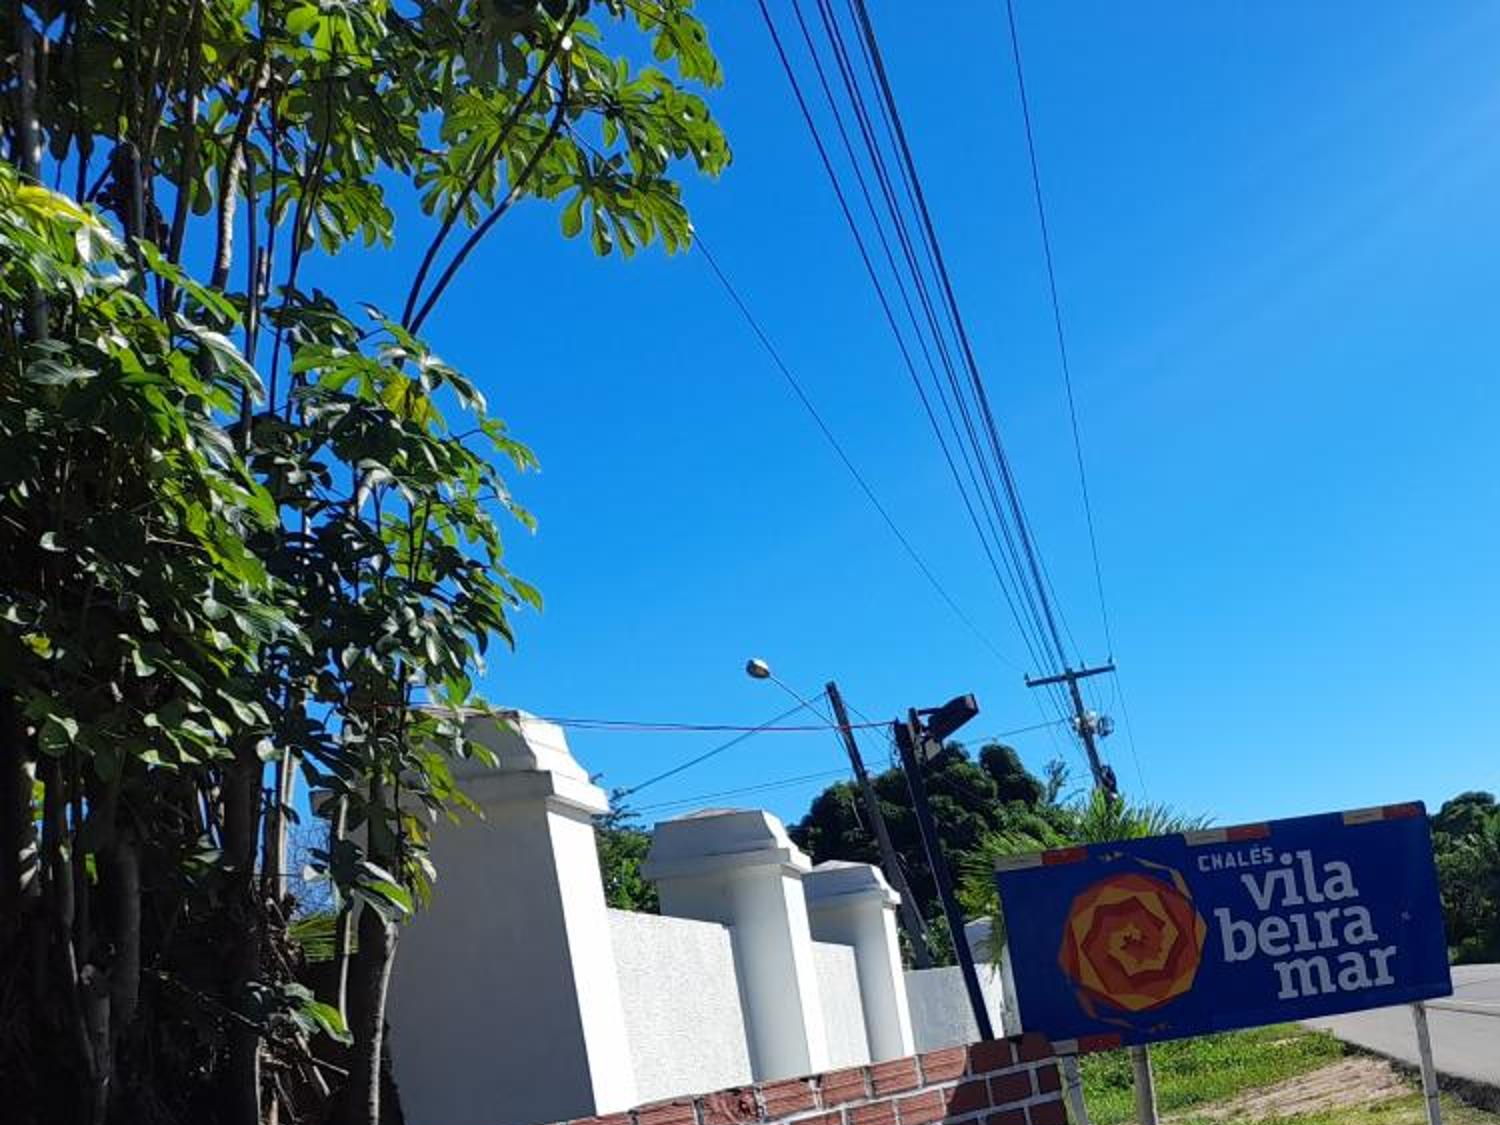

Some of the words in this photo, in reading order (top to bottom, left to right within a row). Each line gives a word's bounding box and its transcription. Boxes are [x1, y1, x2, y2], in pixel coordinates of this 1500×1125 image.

[1198, 845, 1275, 872] CHALÉS
[1241, 850, 1359, 911] vila
[1213, 905, 1379, 963] beira
[1273, 945, 1397, 999] mar
